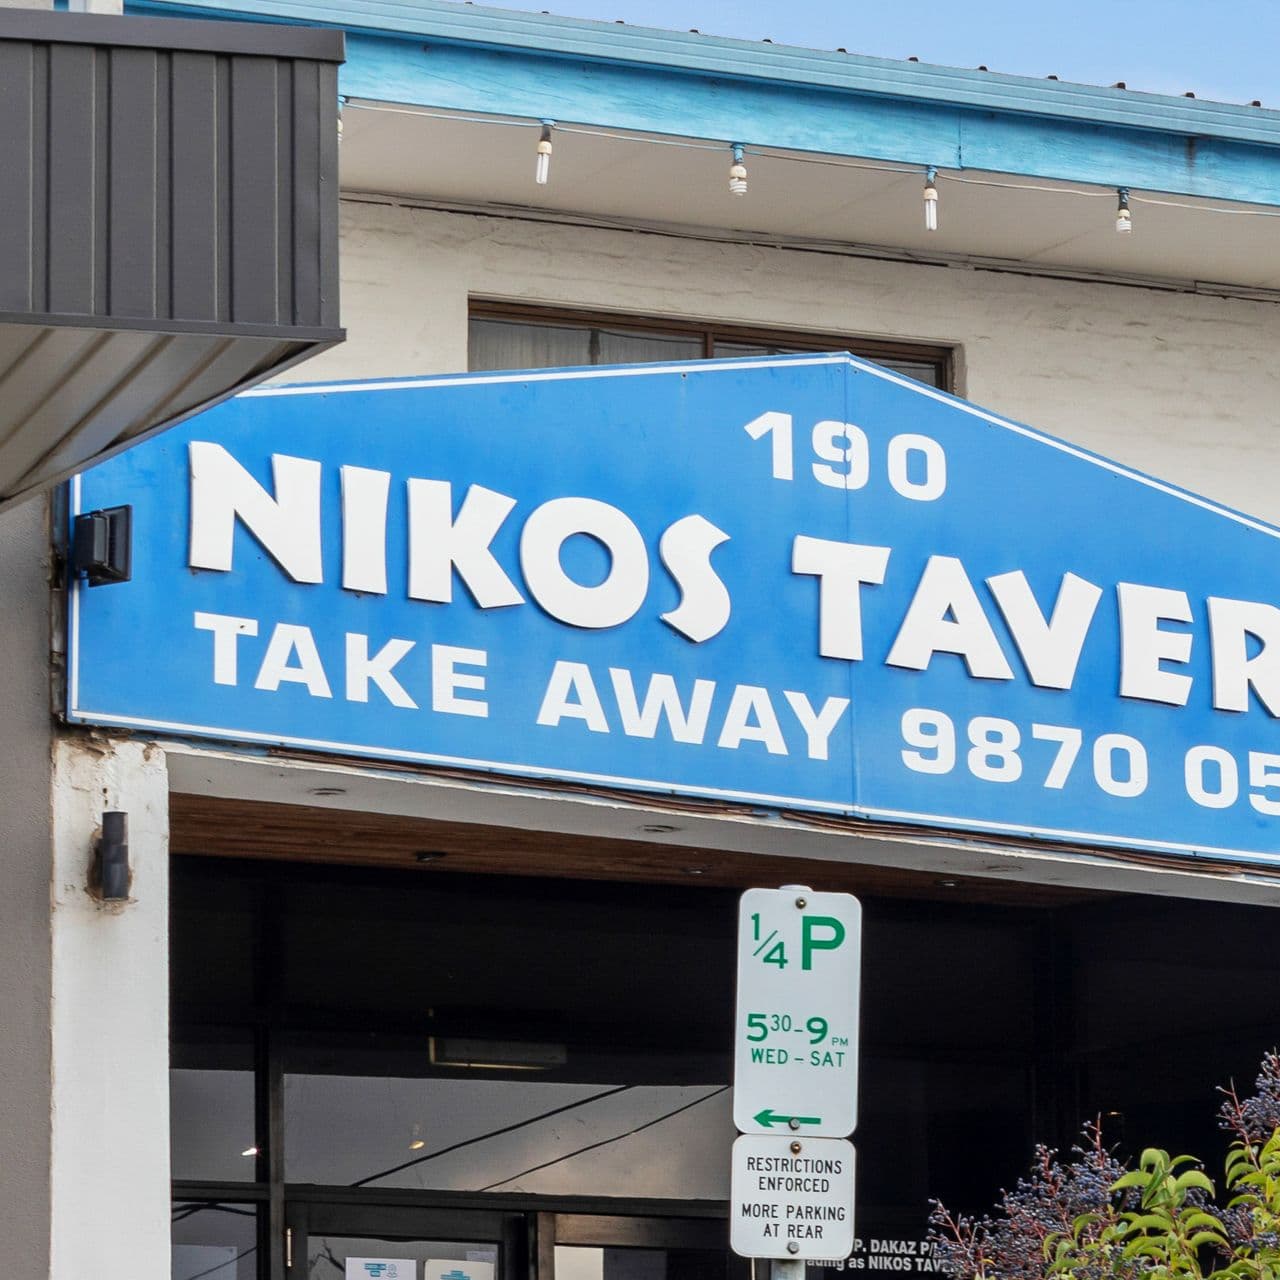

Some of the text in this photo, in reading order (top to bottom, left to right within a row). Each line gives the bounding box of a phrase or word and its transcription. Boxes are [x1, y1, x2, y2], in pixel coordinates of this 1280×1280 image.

[744, 411, 946, 502] 190
[188, 441, 731, 643] NIKOS
[194, 611, 489, 718] TAKE
[536, 660, 850, 761] AWAY
[900, 708, 1149, 797] 9870
[752, 1048, 788, 1064] WED
[811, 1051, 845, 1067] SAT
[747, 1157, 842, 1174] RESTRICTIONS
[759, 1177, 829, 1192] ENFORCED
[742, 1203, 845, 1221] MORE PARKING
[763, 1224, 823, 1239] AT REAR
[871, 1239, 917, 1254] DAKAZ
[848, 1258, 865, 1269] as
[868, 1256, 912, 1271] NIKOS
